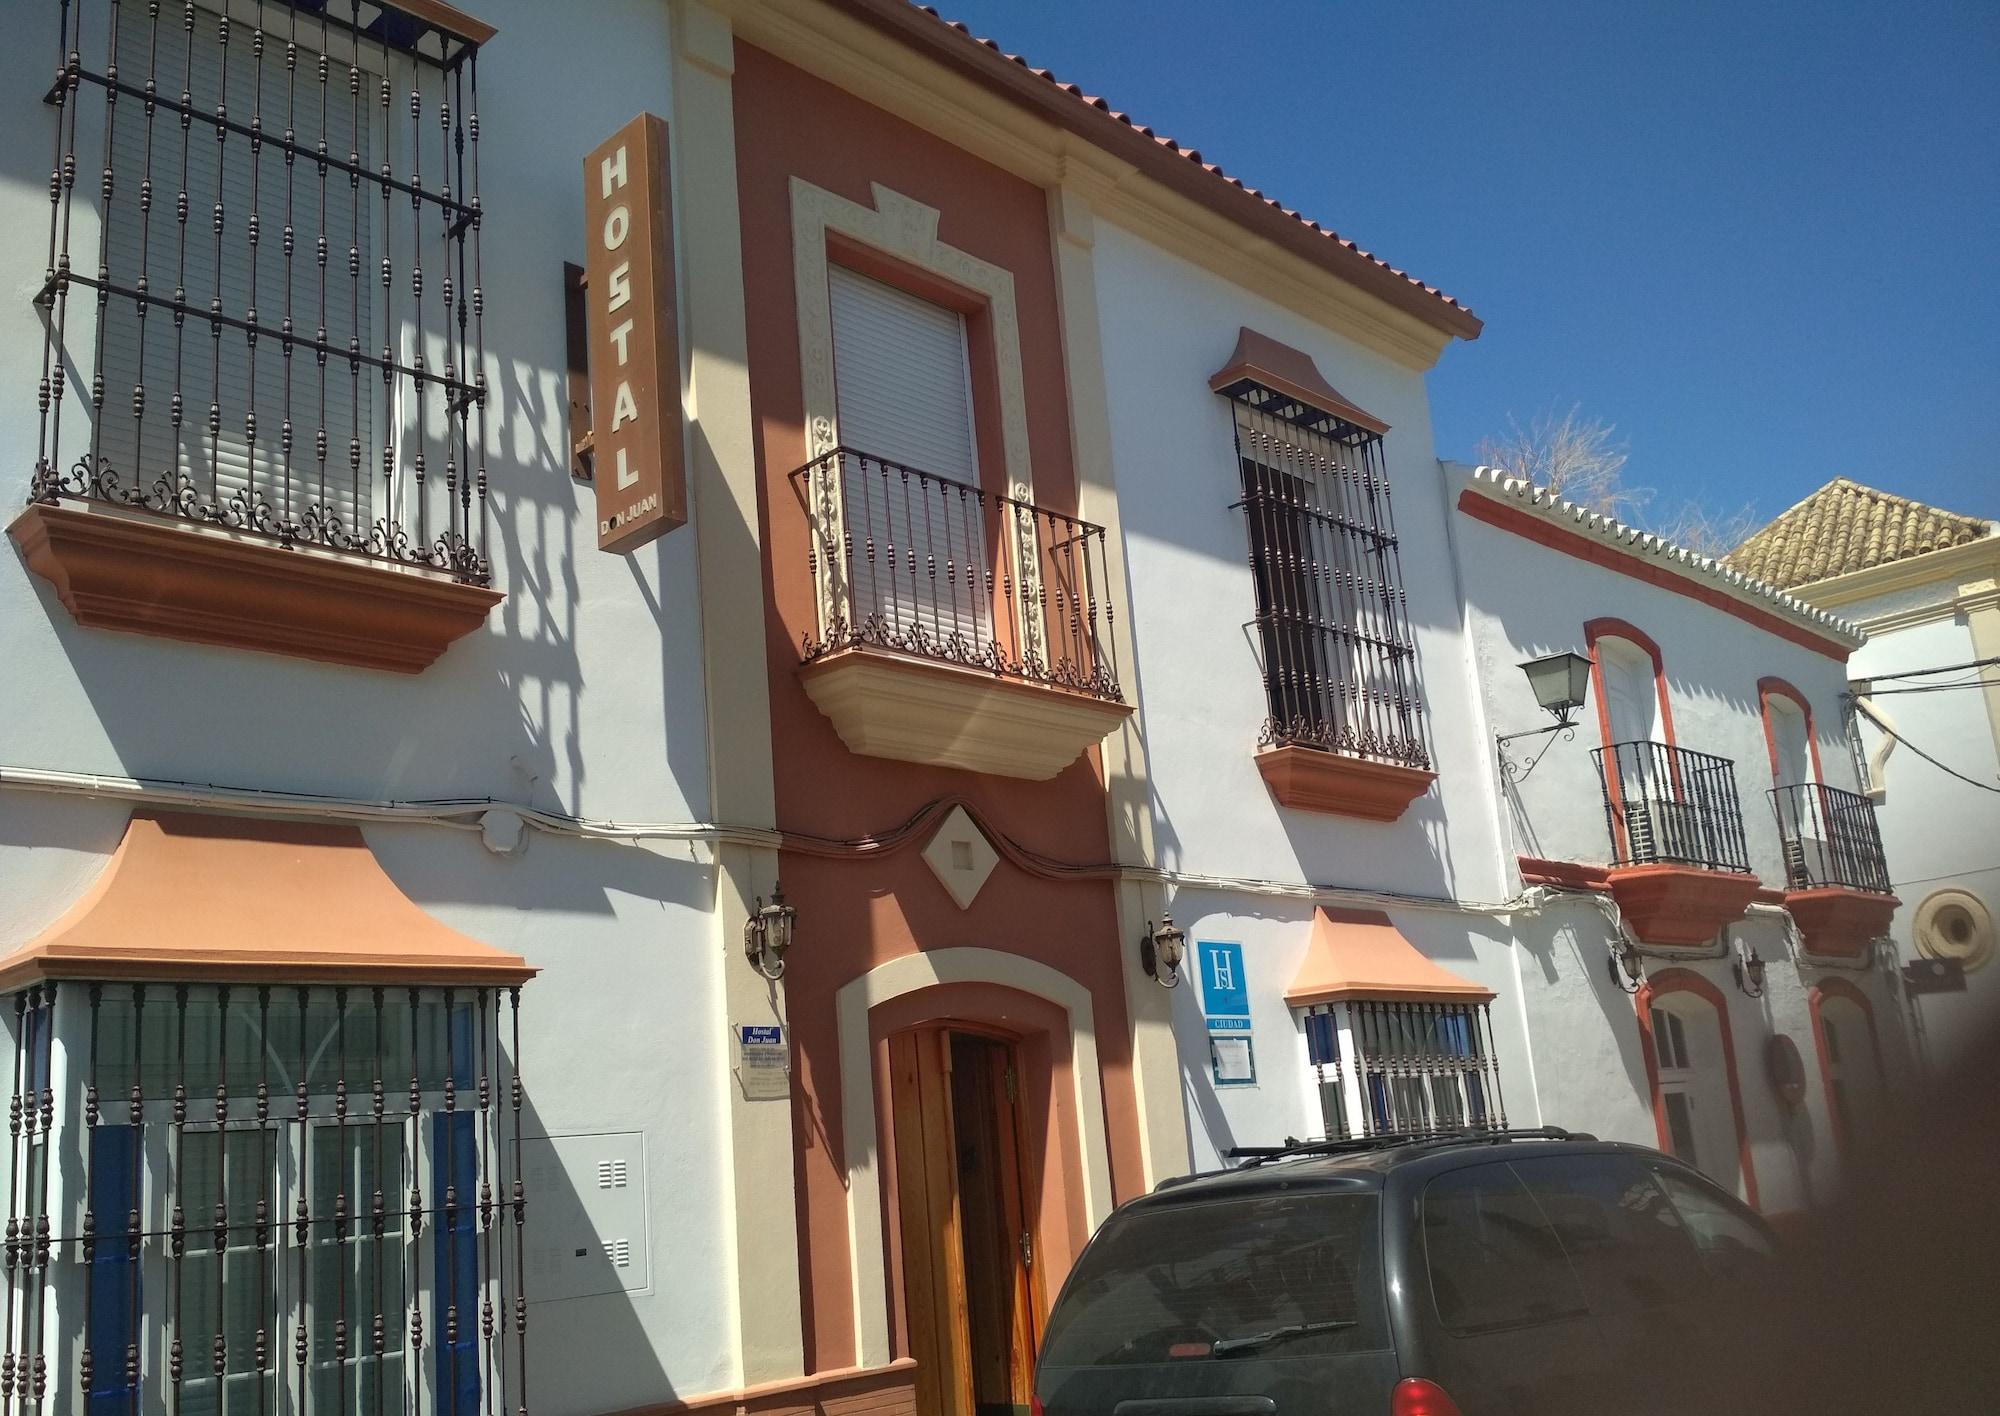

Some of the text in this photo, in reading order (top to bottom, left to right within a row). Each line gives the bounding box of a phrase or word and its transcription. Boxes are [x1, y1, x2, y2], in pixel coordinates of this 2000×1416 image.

[601, 145, 639, 492] HOSTAL
[626, 493, 657, 522] JUAN
[1214, 1019, 1244, 1029] CIUDAD
[752, 1027, 772, 1036] Hostal
[747, 1035, 777, 1044] Don Juan
